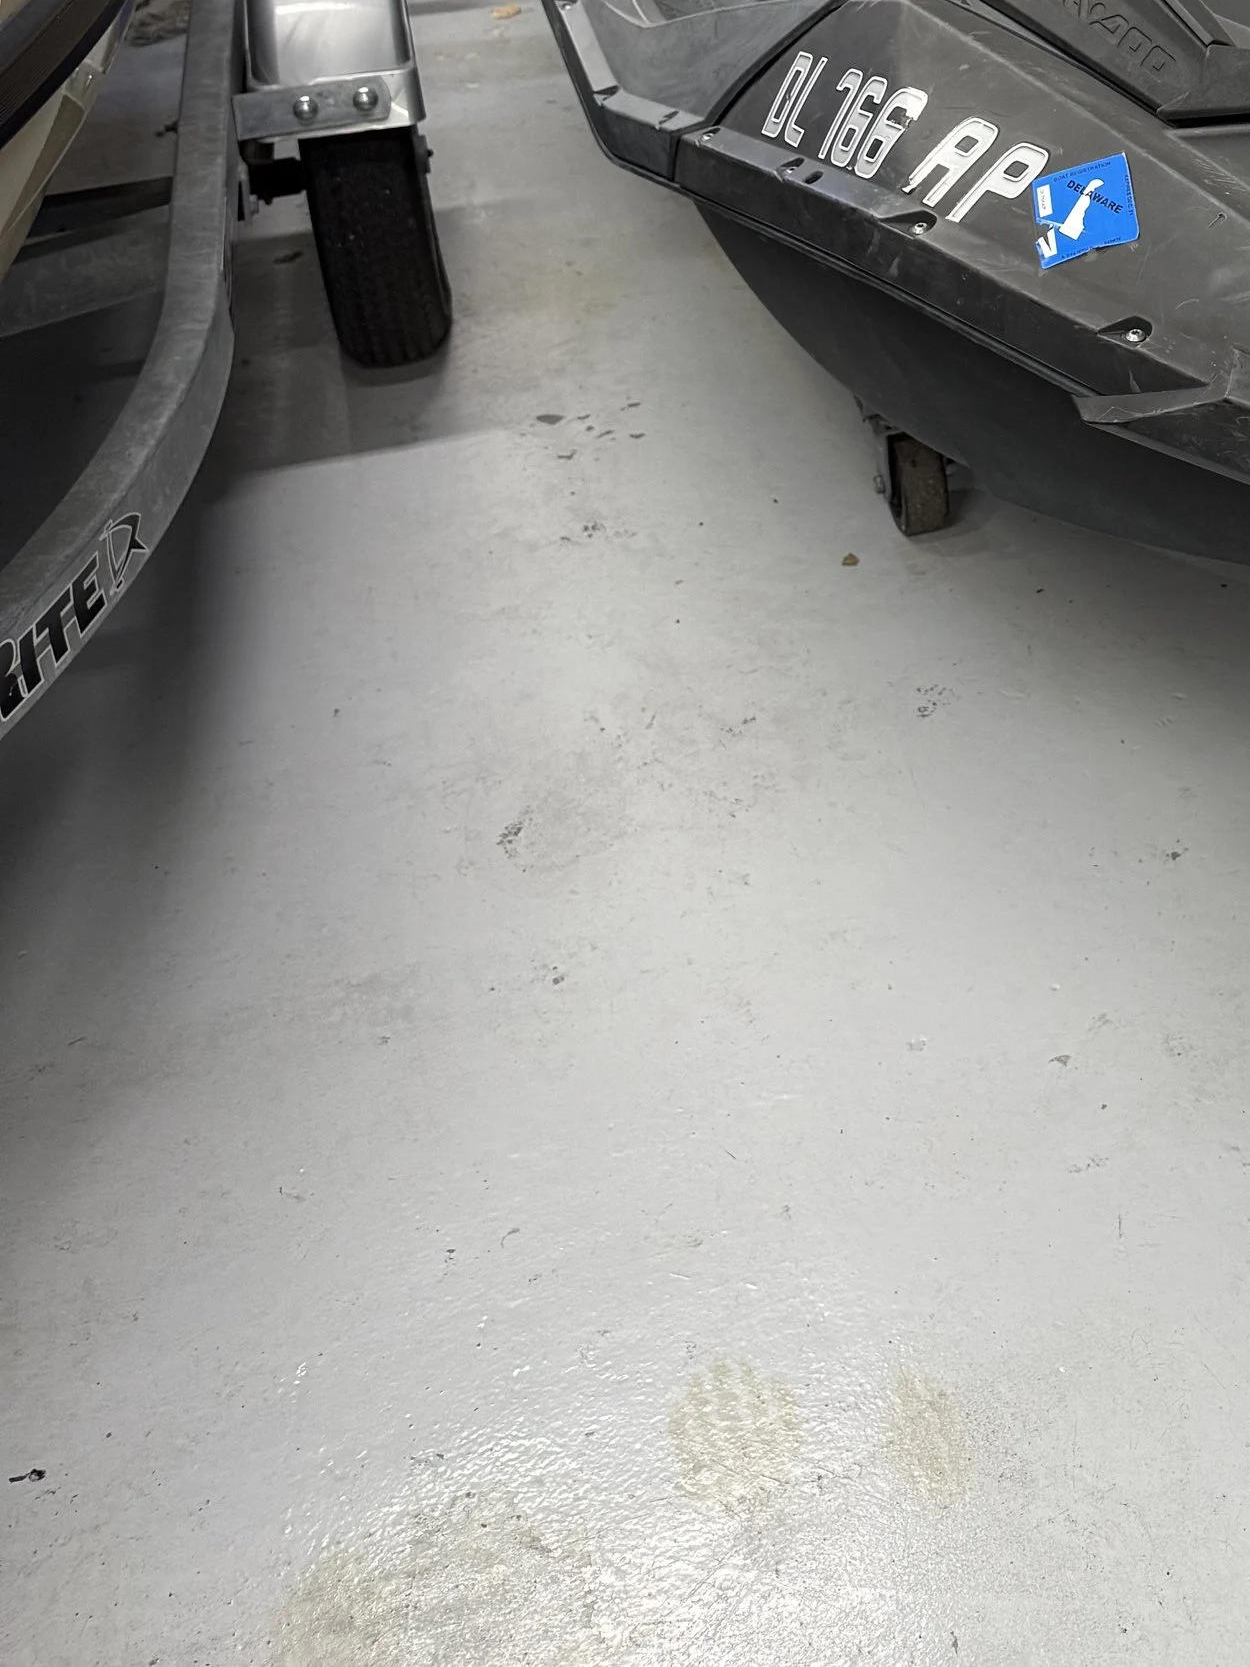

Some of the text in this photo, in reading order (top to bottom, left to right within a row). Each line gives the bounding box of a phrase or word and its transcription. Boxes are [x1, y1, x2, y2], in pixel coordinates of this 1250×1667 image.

[760, 50, 829, 148] DL
[902, 117, 1050, 223] AP
[1066, 180, 1124, 214] DELAWARE
